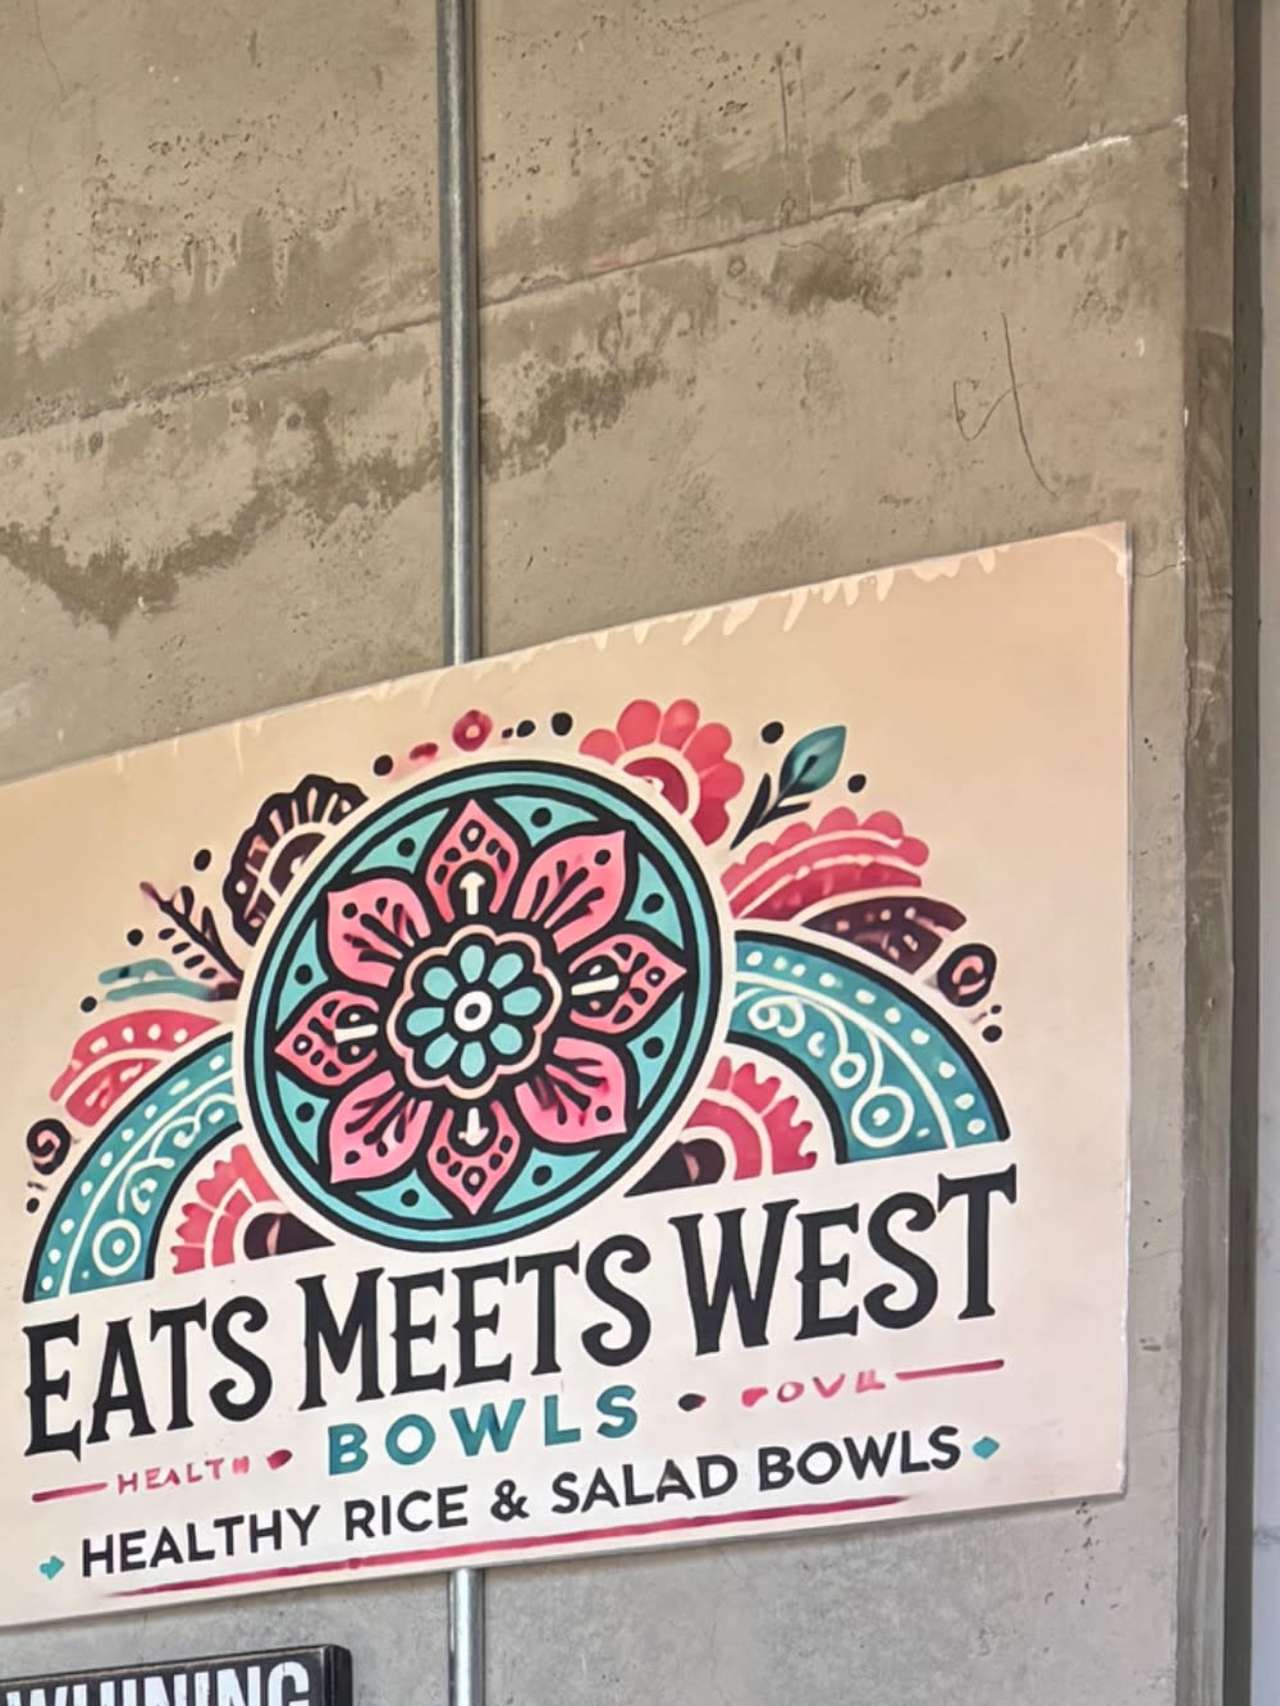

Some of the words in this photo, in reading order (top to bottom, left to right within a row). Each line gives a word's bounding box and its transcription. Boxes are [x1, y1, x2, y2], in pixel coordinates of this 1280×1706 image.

[22, 1296, 273, 1462] EATS
[295, 1235, 652, 1411] MEETS
[668, 1163, 1018, 1357] WEST
[81, 1504, 321, 1578] HEALTHY
[345, 1484, 469, 1541] RICE
[490, 1479, 530, 1523] &
[551, 1455, 739, 1514] SALAD
[758, 1425, 962, 1492] BOWLS
[328, 1384, 638, 1476] BOWLS
